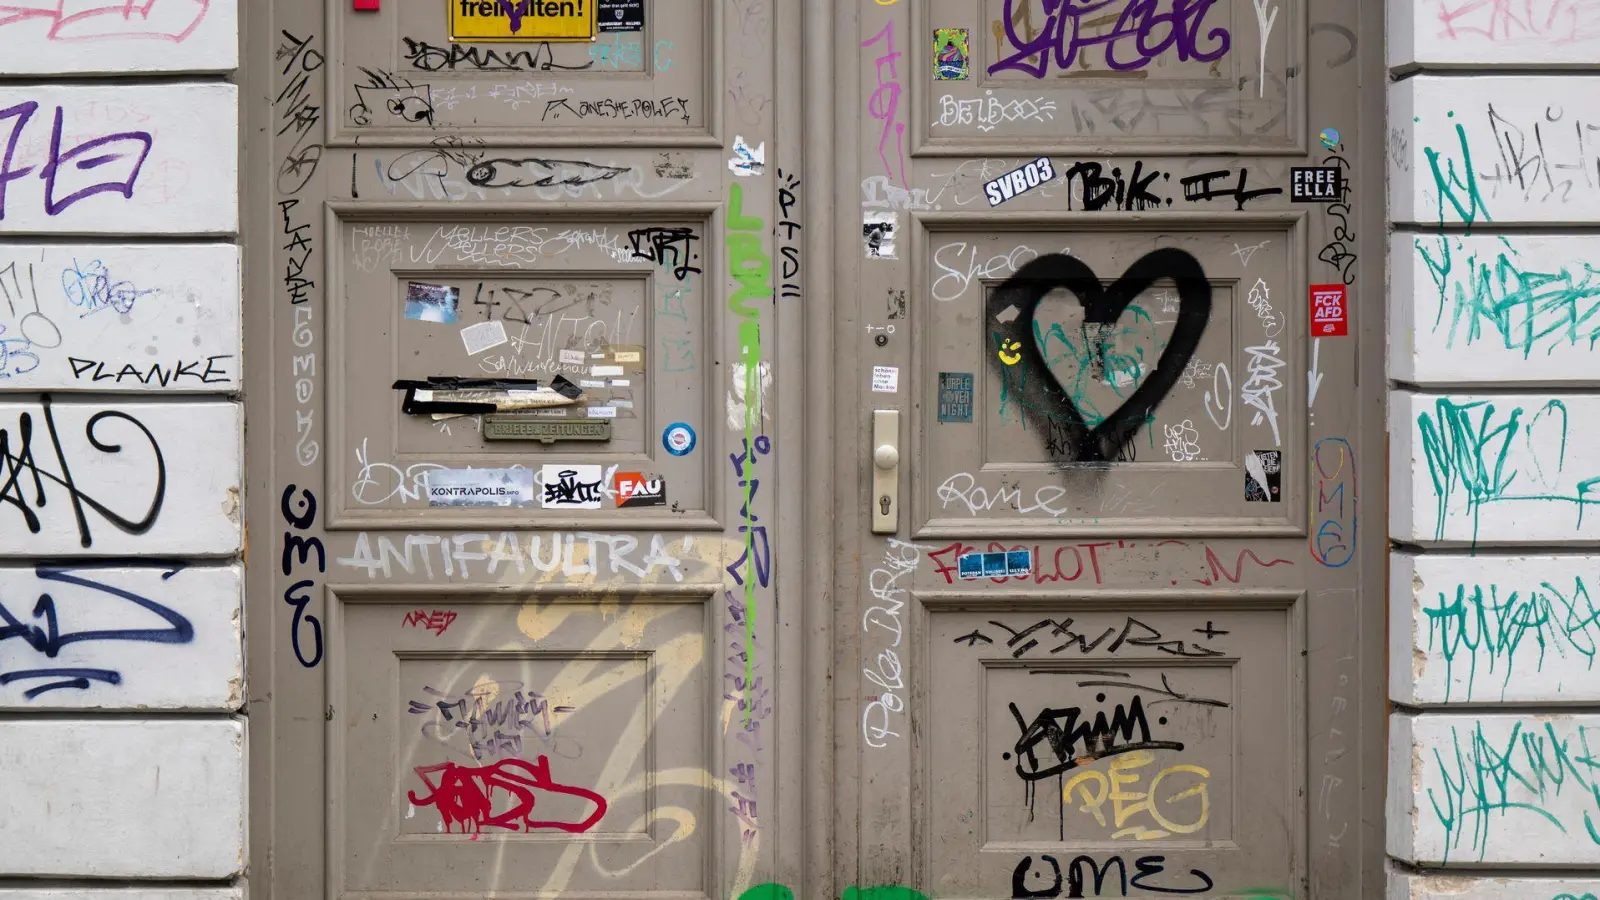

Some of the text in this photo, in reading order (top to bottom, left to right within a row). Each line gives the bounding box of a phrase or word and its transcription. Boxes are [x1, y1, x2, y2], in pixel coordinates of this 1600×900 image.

[986, 157, 1053, 206] SVB03
[1294, 170, 1335, 183] FREE
[1294, 183, 1335, 197] ELLA
[1314, 295, 1341, 307] FCK
[1315, 307, 1342, 319] AFD
[68, 355, 234, 387] PLANKE
[941, 403, 969, 417] NIGHT
[620, 480, 661, 496] FAU
[1063, 750, 1212, 834] PEG
